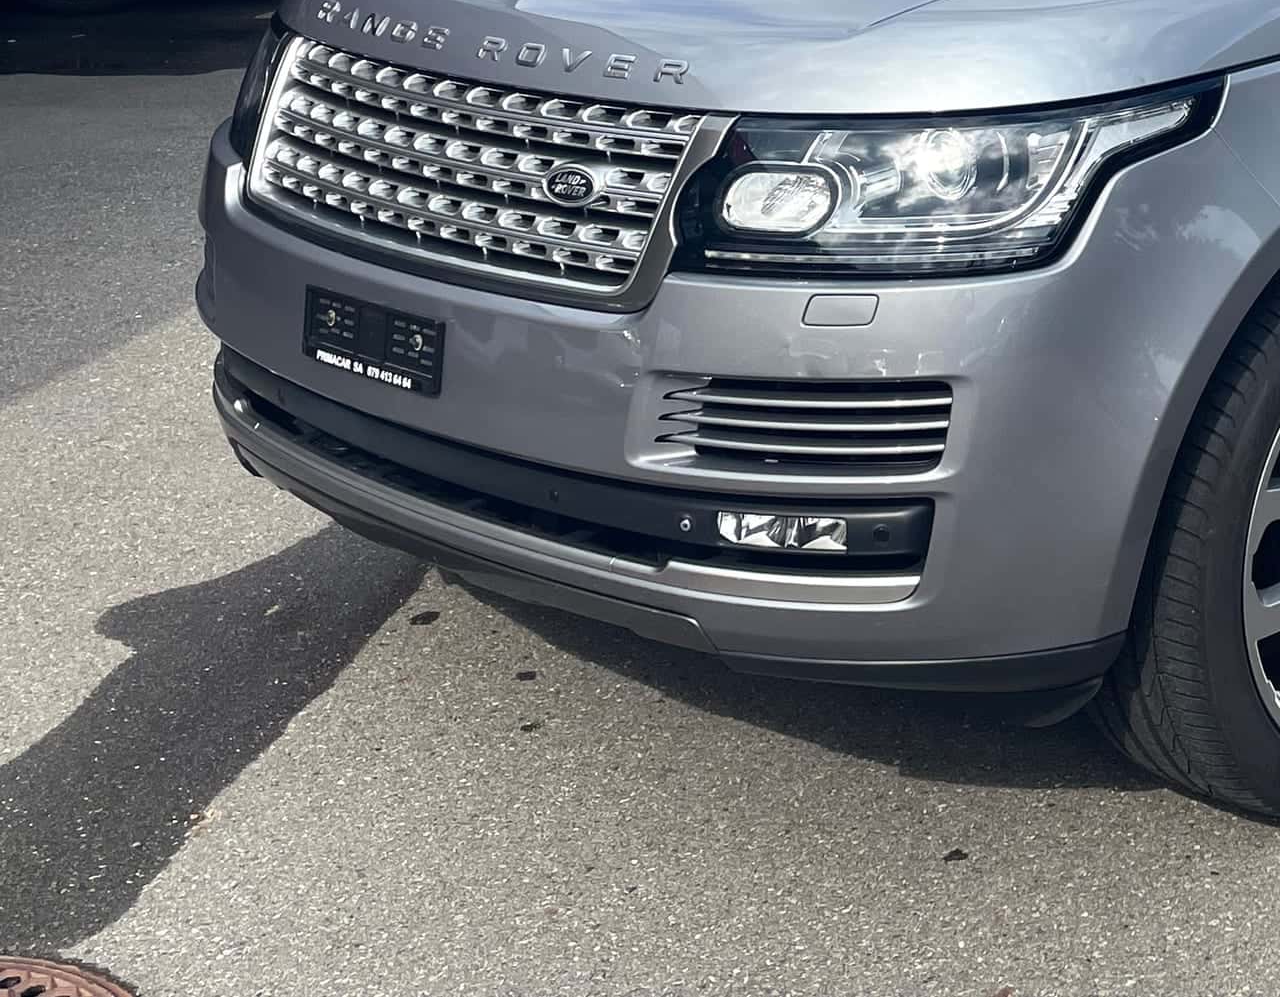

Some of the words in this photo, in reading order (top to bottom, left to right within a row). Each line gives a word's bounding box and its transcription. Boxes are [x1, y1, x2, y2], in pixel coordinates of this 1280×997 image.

[476, 35, 690, 85] ROVER
[554, 183, 587, 197] ROVER
[316, 349, 352, 370] PRIMACAR
[352, 361, 364, 375] SA
[366, 365, 380, 379] 079
[380, 370, 393, 384] 413
[402, 377, 412, 389] 64
